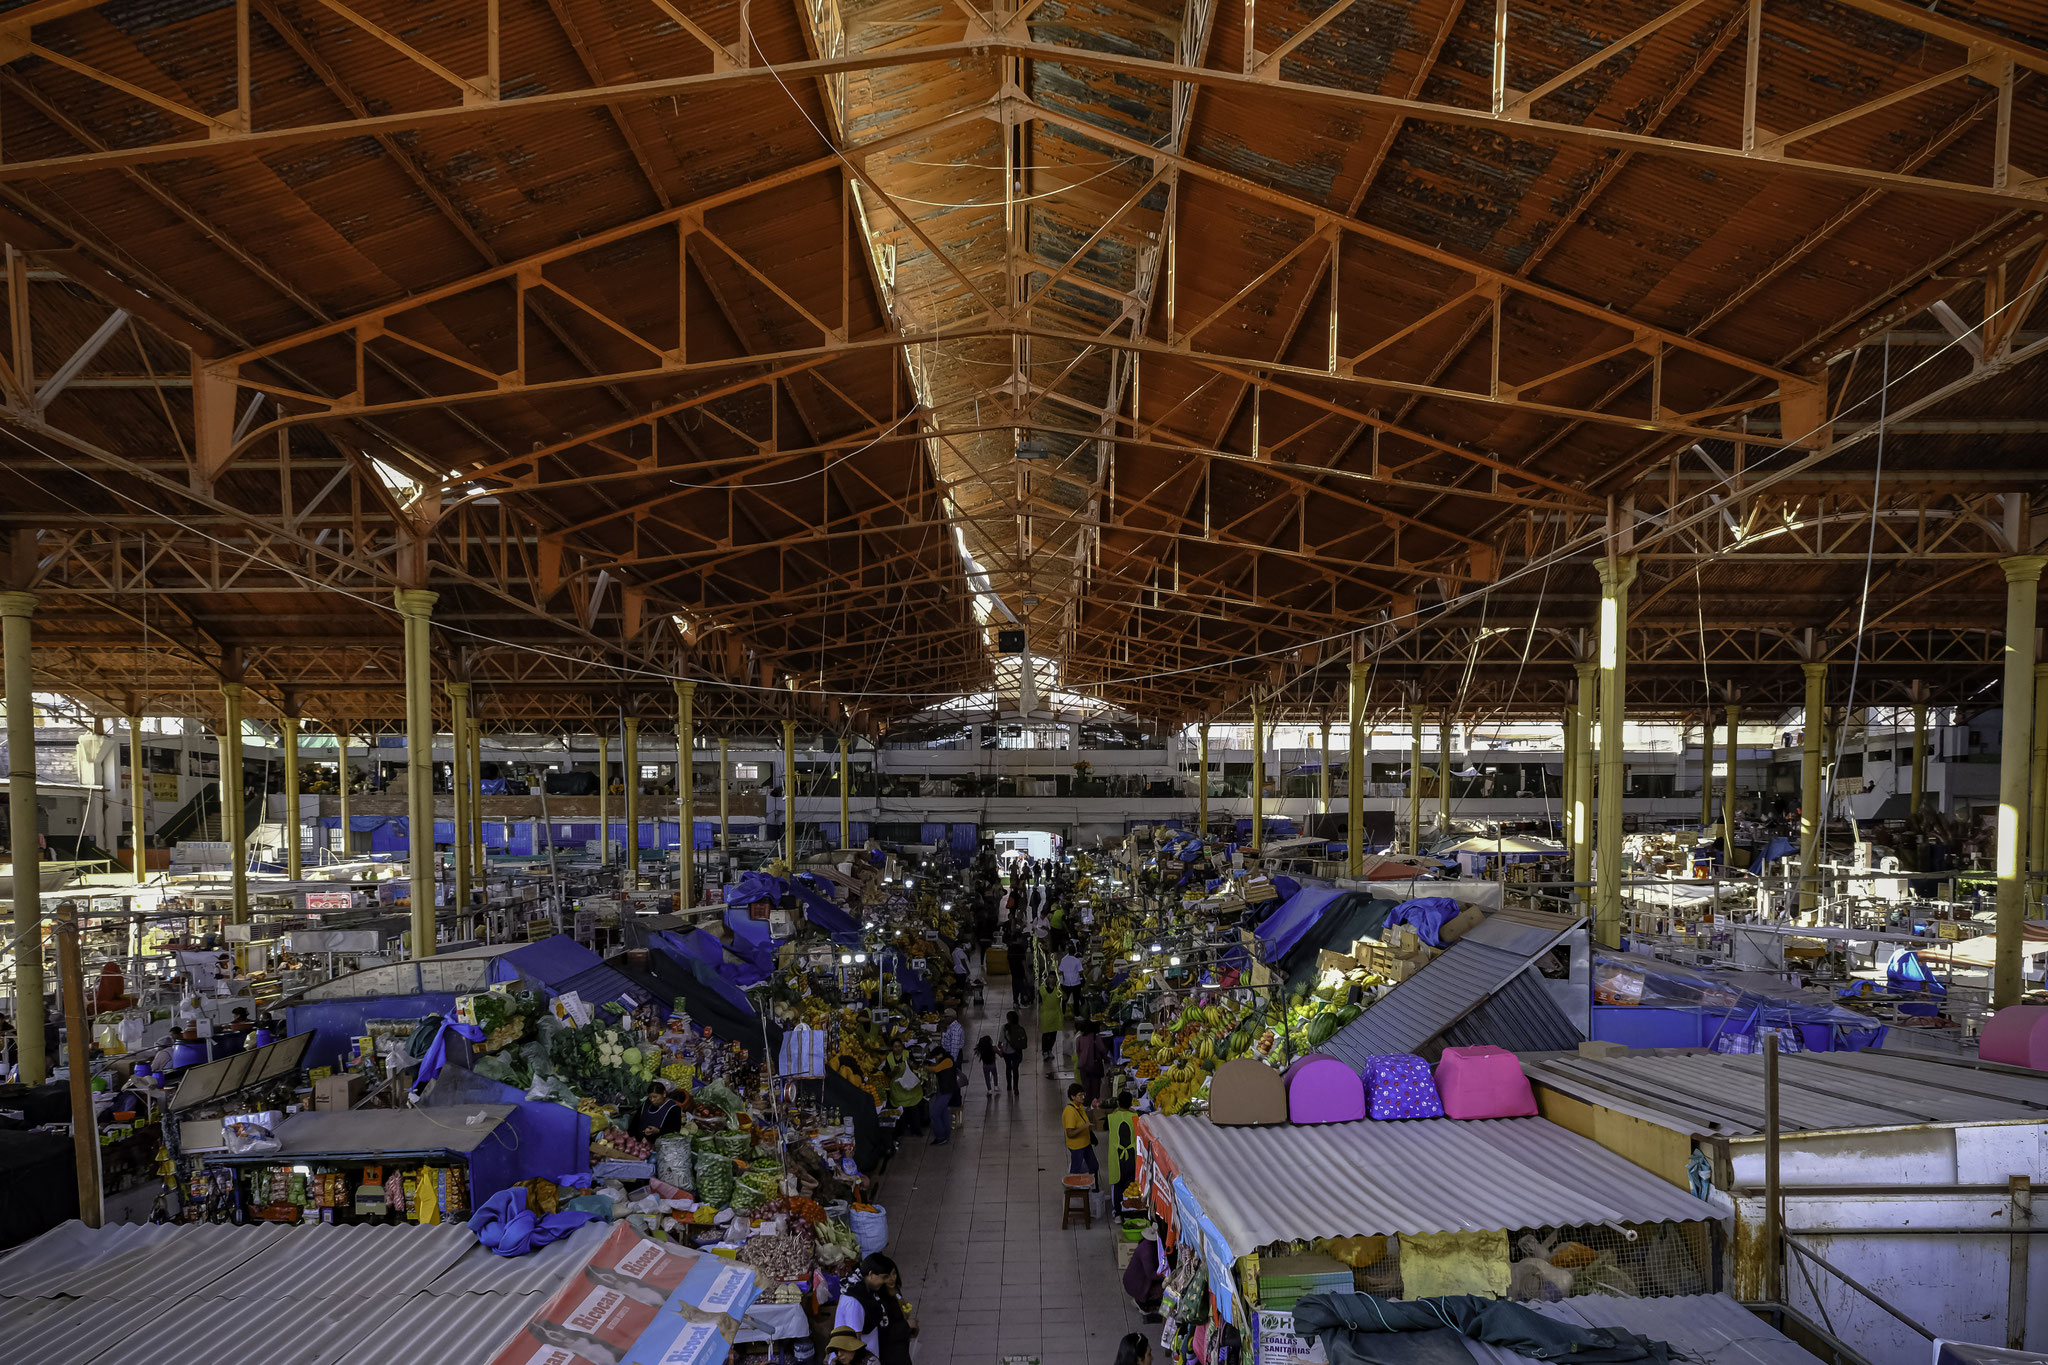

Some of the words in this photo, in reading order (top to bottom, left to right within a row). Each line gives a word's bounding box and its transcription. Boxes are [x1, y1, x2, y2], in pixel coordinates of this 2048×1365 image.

[621, 1246, 662, 1276] Ricocan
[707, 1269, 747, 1305] Ricocat
[571, 1291, 620, 1330] Ricocan
[666, 1326, 711, 1363] Ricocat
[1264, 1345, 1311, 1355] SANITARIAS
[1265, 1337, 1298, 1345] TOALLAS
